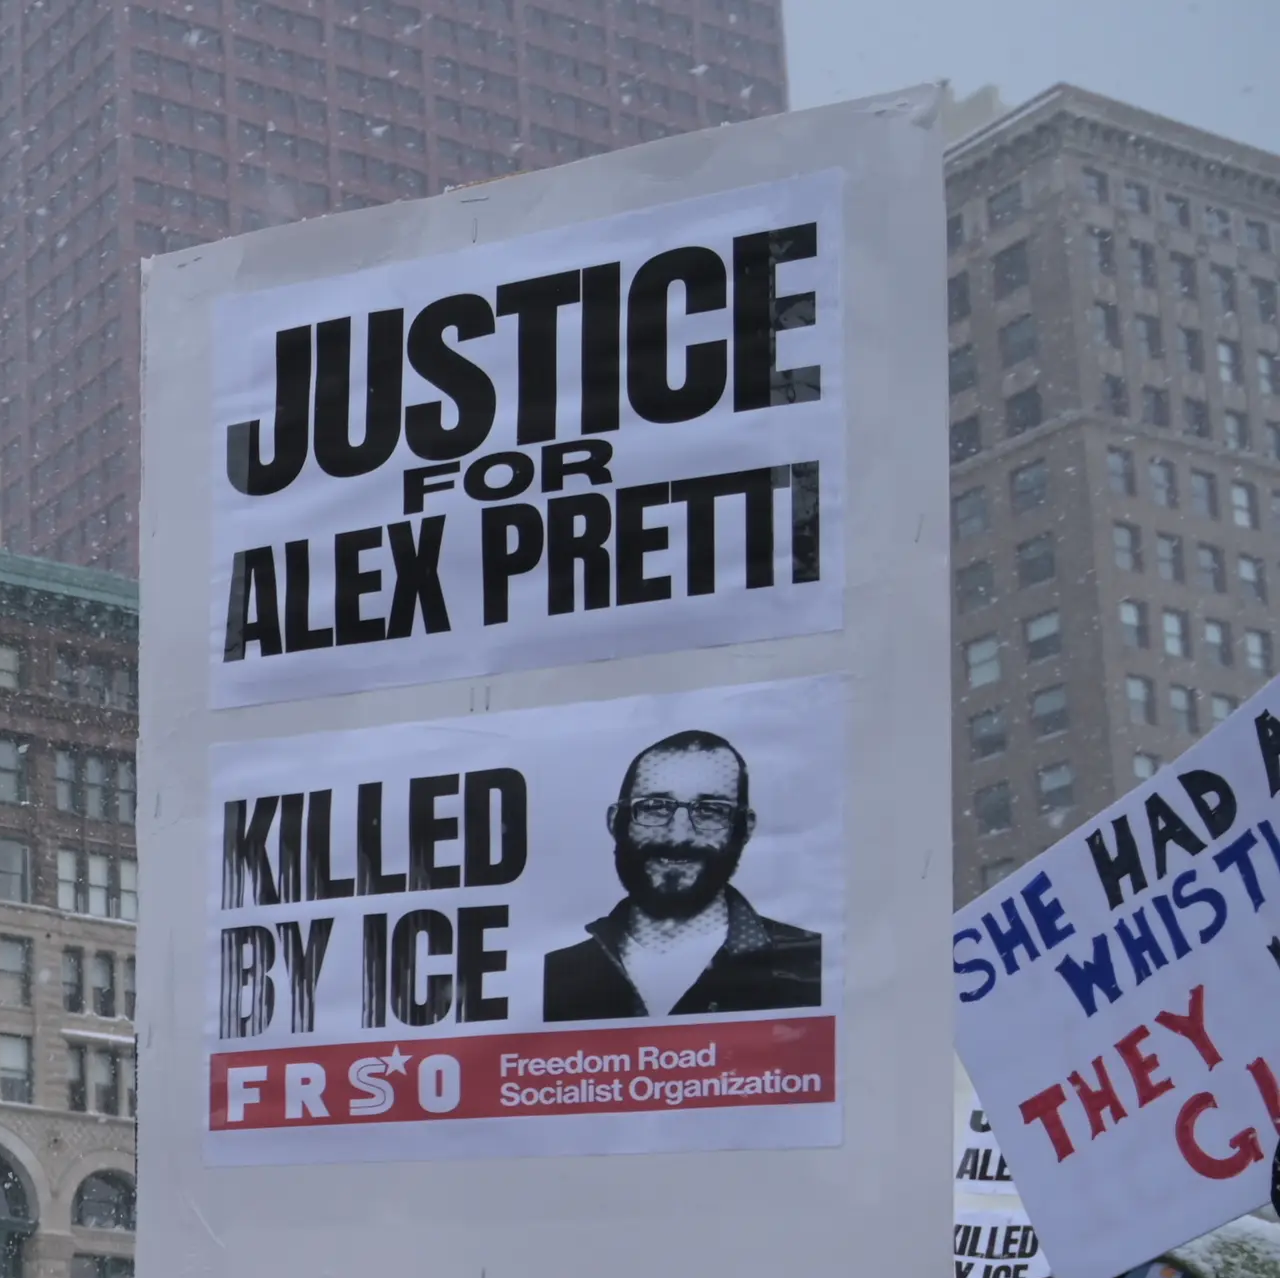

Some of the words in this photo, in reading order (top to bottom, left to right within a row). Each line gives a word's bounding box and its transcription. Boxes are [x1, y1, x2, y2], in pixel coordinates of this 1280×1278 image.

[227, 222, 821, 497] JUSTICE
[403, 439, 613, 513] FOR
[223, 514, 451, 662] ALEX
[482, 460, 820, 627] PRETTI
[221, 767, 528, 909] KILLED
[953, 871, 1076, 1003] SHE
[1085, 768, 1238, 911] HAD
[219, 917, 334, 1041] BY
[361, 904, 509, 1029] ICE
[227, 1052, 461, 1122] FRSO
[500, 1049, 631, 1078] Freedom
[638, 1042, 717, 1071] Road
[500, 1079, 623, 1108] Socialist
[628, 1069, 822, 1106] Organization
[1018, 984, 1223, 1164] THEY
[955, 1148, 1014, 1181] ALE
